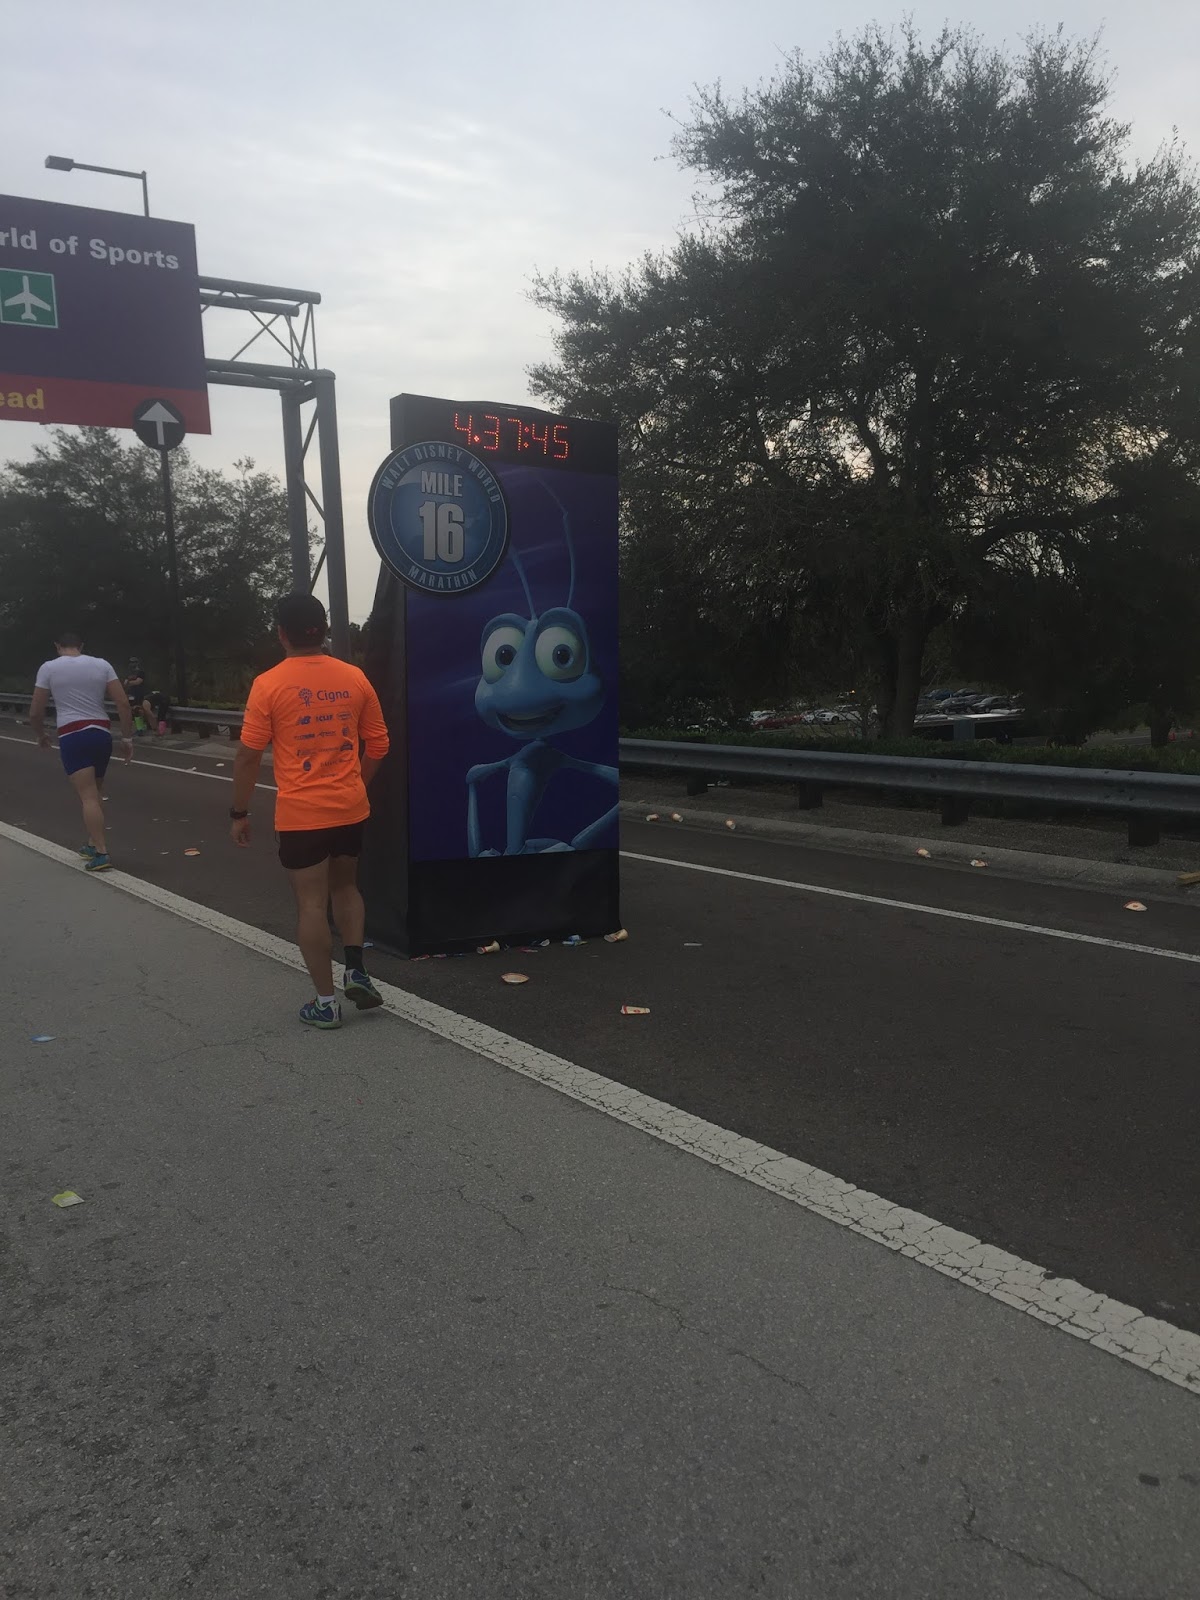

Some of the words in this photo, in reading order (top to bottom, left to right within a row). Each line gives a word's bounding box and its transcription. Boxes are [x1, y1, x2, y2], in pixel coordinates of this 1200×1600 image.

[49, 236, 79, 256] of
[89, 239, 179, 269] Sports
[382, 457, 410, 490] WALT
[414, 445, 463, 463] DISNEY
[468, 459, 501, 503] WORLD
[420, 470, 463, 497] MILE
[419, 501, 464, 563] 16
[408, 565, 477, 589] MARATHON
